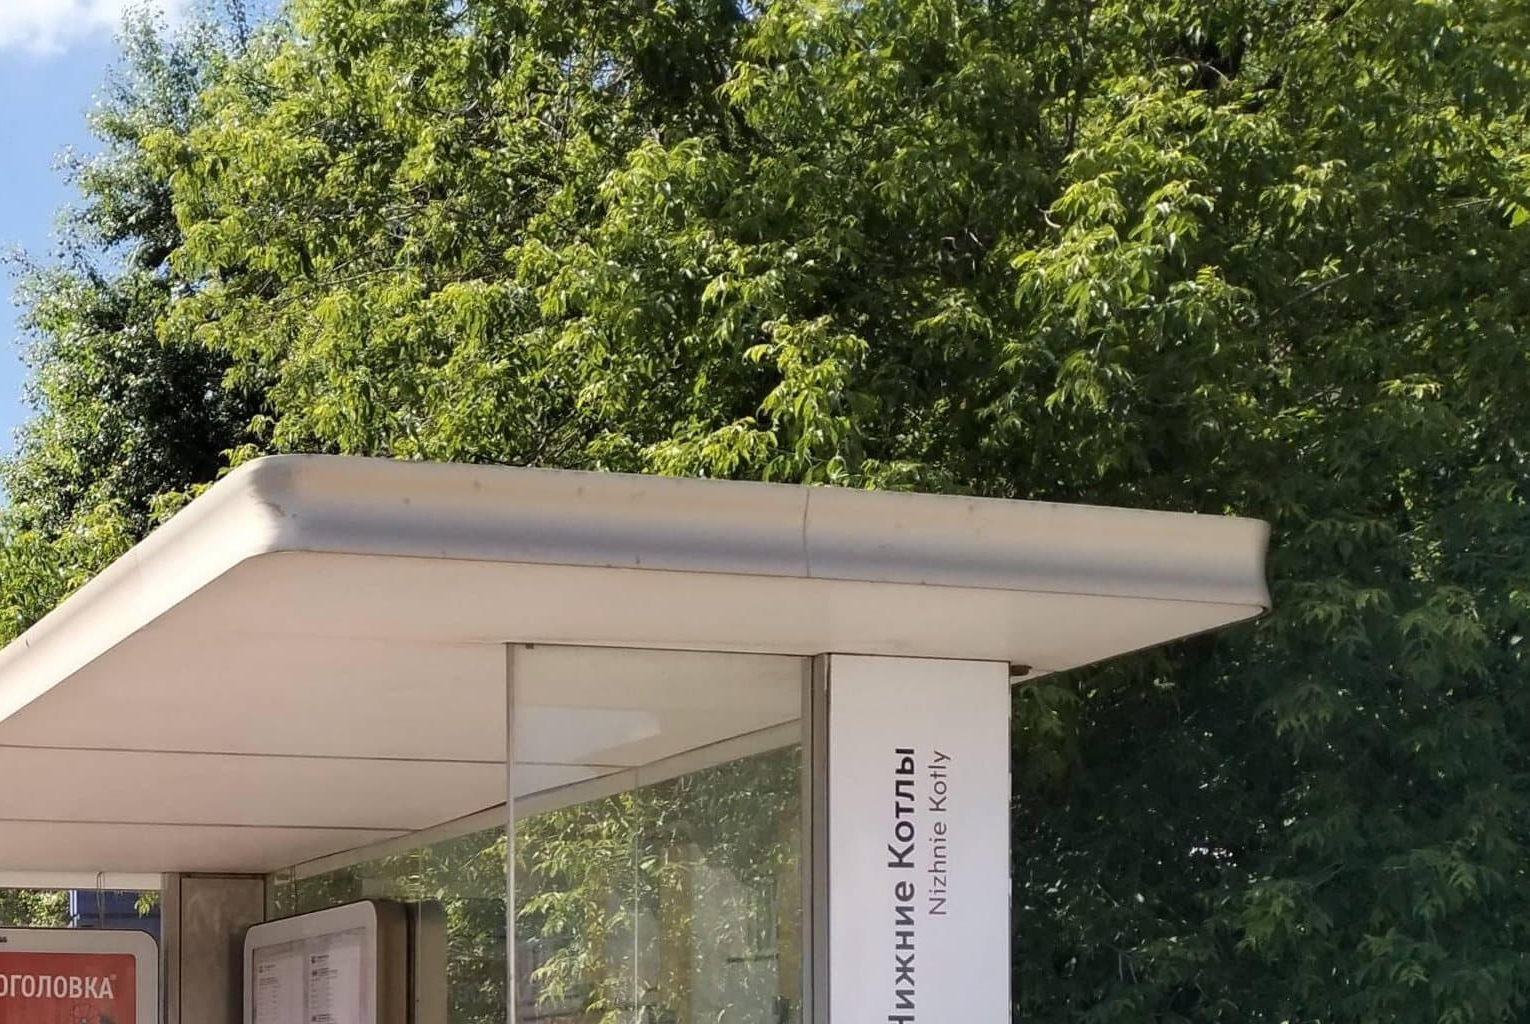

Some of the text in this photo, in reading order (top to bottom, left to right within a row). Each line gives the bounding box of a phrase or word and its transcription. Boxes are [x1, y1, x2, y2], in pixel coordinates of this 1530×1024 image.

[887, 748, 915, 868] Котлы
[928, 750, 951, 915] Nizhnie Kotly
